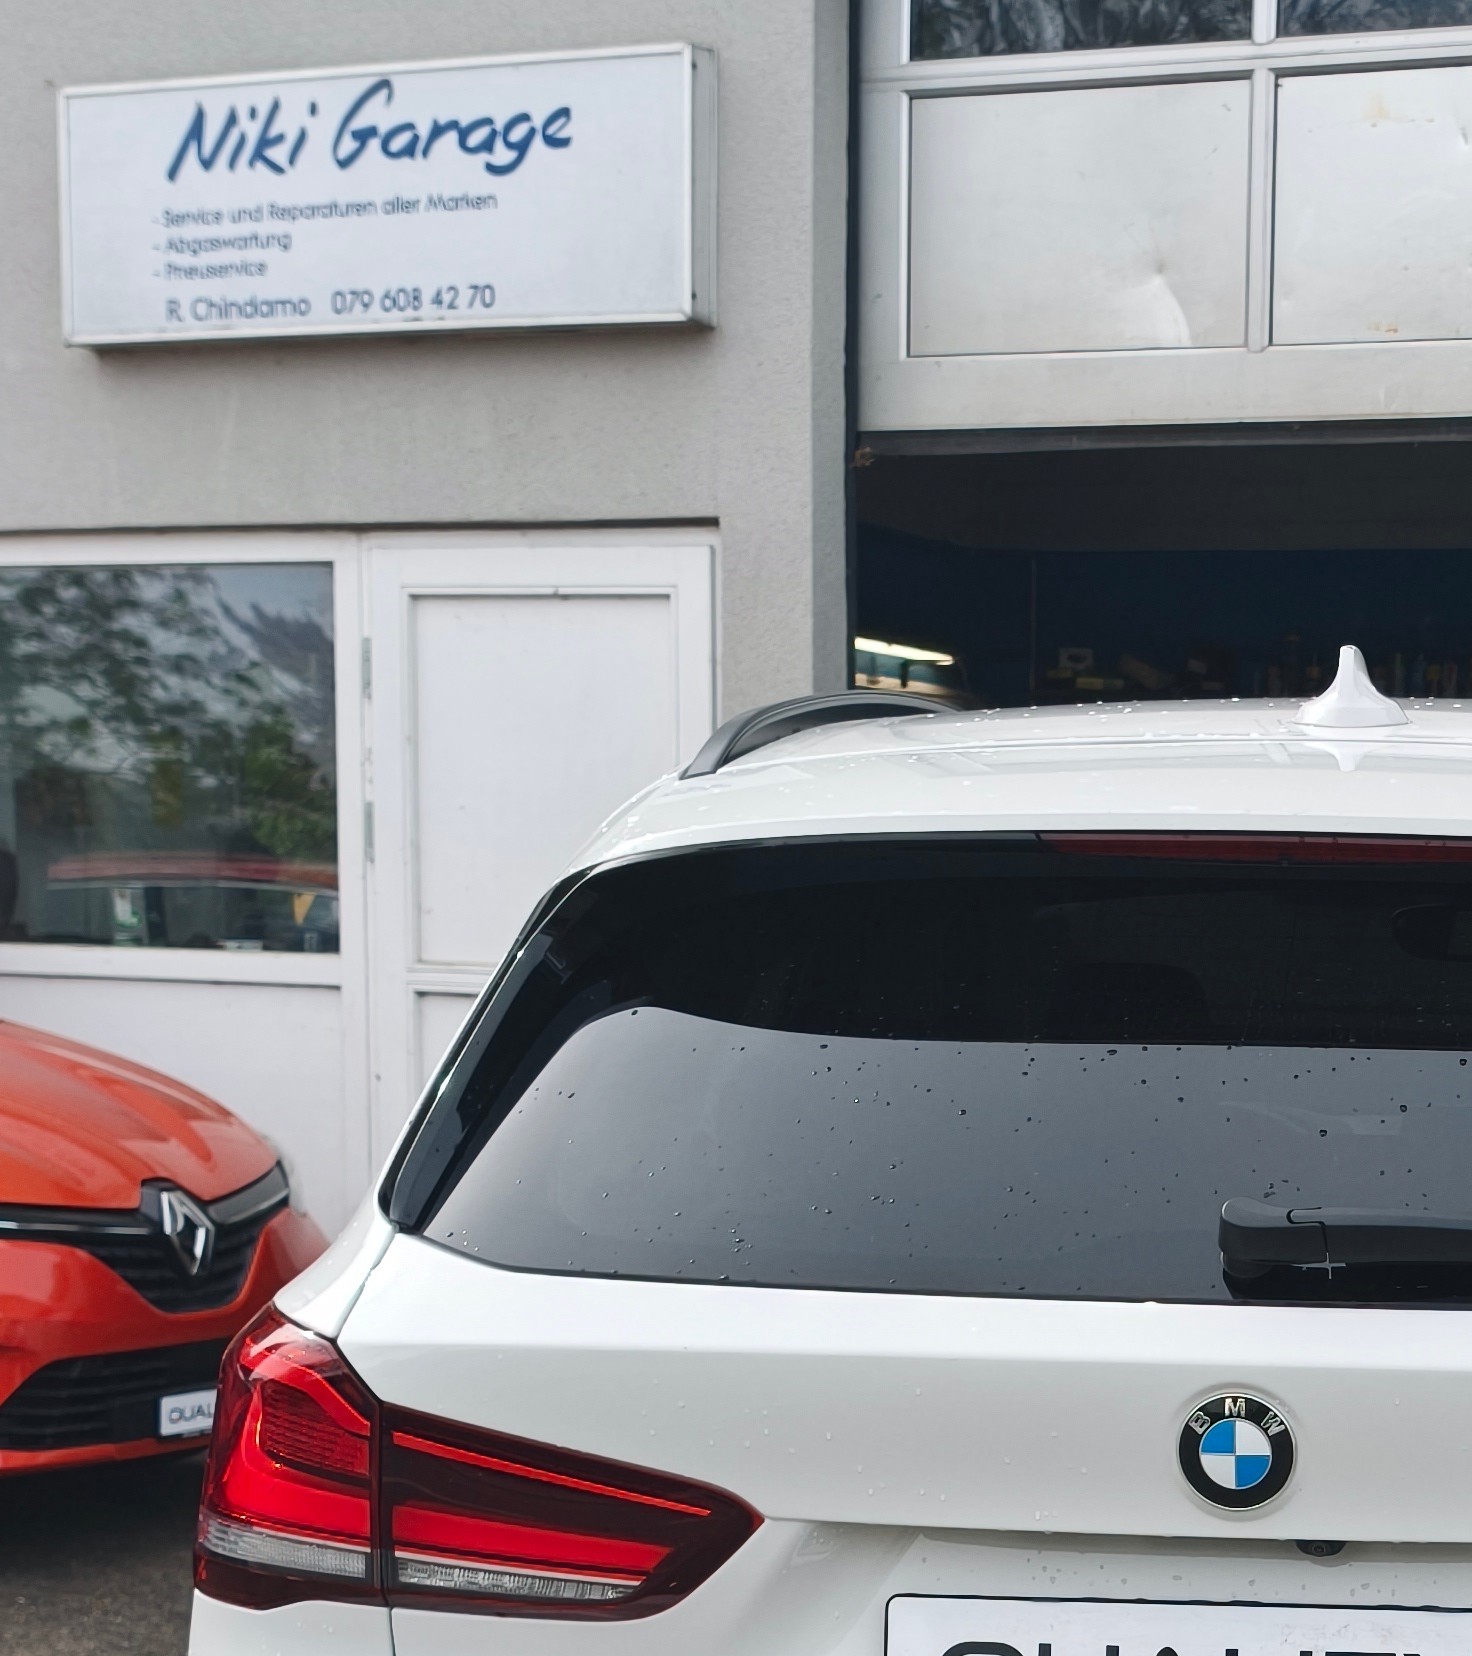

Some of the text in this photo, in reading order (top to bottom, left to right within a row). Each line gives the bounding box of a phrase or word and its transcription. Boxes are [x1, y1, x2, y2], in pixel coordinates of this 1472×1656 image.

[166, 79, 574, 182] Niki Garage
[163, 208, 225, 227] Service
[229, 206, 264, 224] und
[269, 202, 378, 223] Reparaturen
[381, 196, 420, 216] aller
[426, 193, 498, 212] Marken
[190, 294, 312, 321] Chindamo
[331, 290, 374, 314] 079
[380, 287, 423, 312] 608
[431, 285, 460, 309] 42
[467, 284, 496, 308] 70
[168, 1403, 214, 1425] QUAL
[1188, 1398, 1286, 1437] BMW
